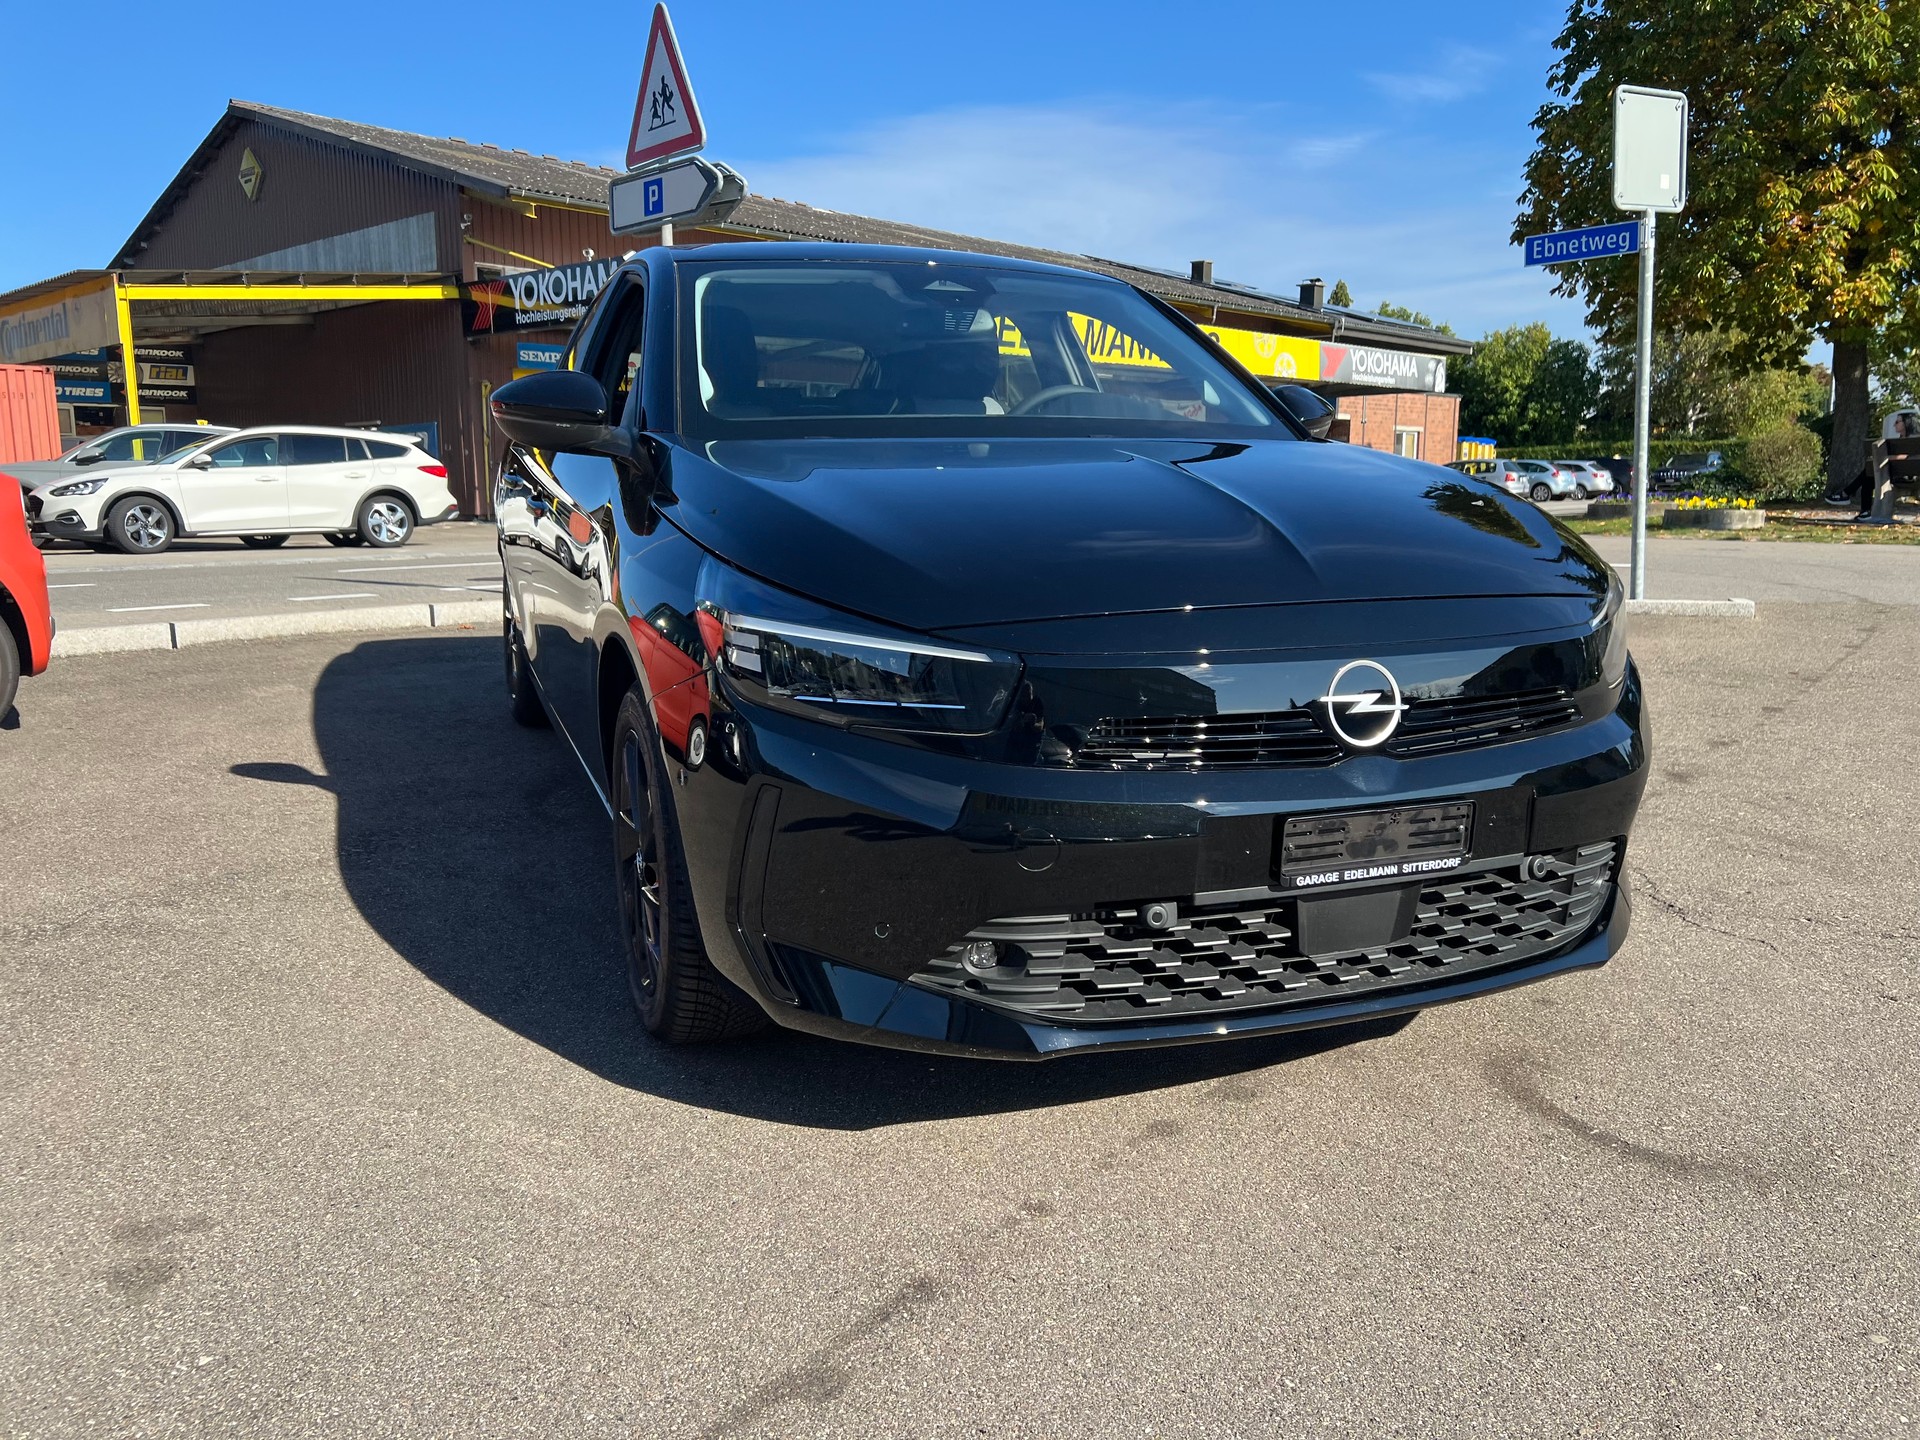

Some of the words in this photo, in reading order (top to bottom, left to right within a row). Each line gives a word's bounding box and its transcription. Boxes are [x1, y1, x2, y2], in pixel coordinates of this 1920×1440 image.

[648, 184, 659, 211] P
[1533, 231, 1630, 259] Ebnetweg
[515, 303, 588, 325] Hochleistungsreife
[0, 302, 69, 359] Continental
[1350, 348, 1418, 378] YOKOHAMA
[64, 387, 104, 397] TIRES
[1296, 872, 1340, 887] GARAGE
[1343, 864, 1398, 880] EDELMANN
[1402, 857, 1462, 874] SITTERDORF
